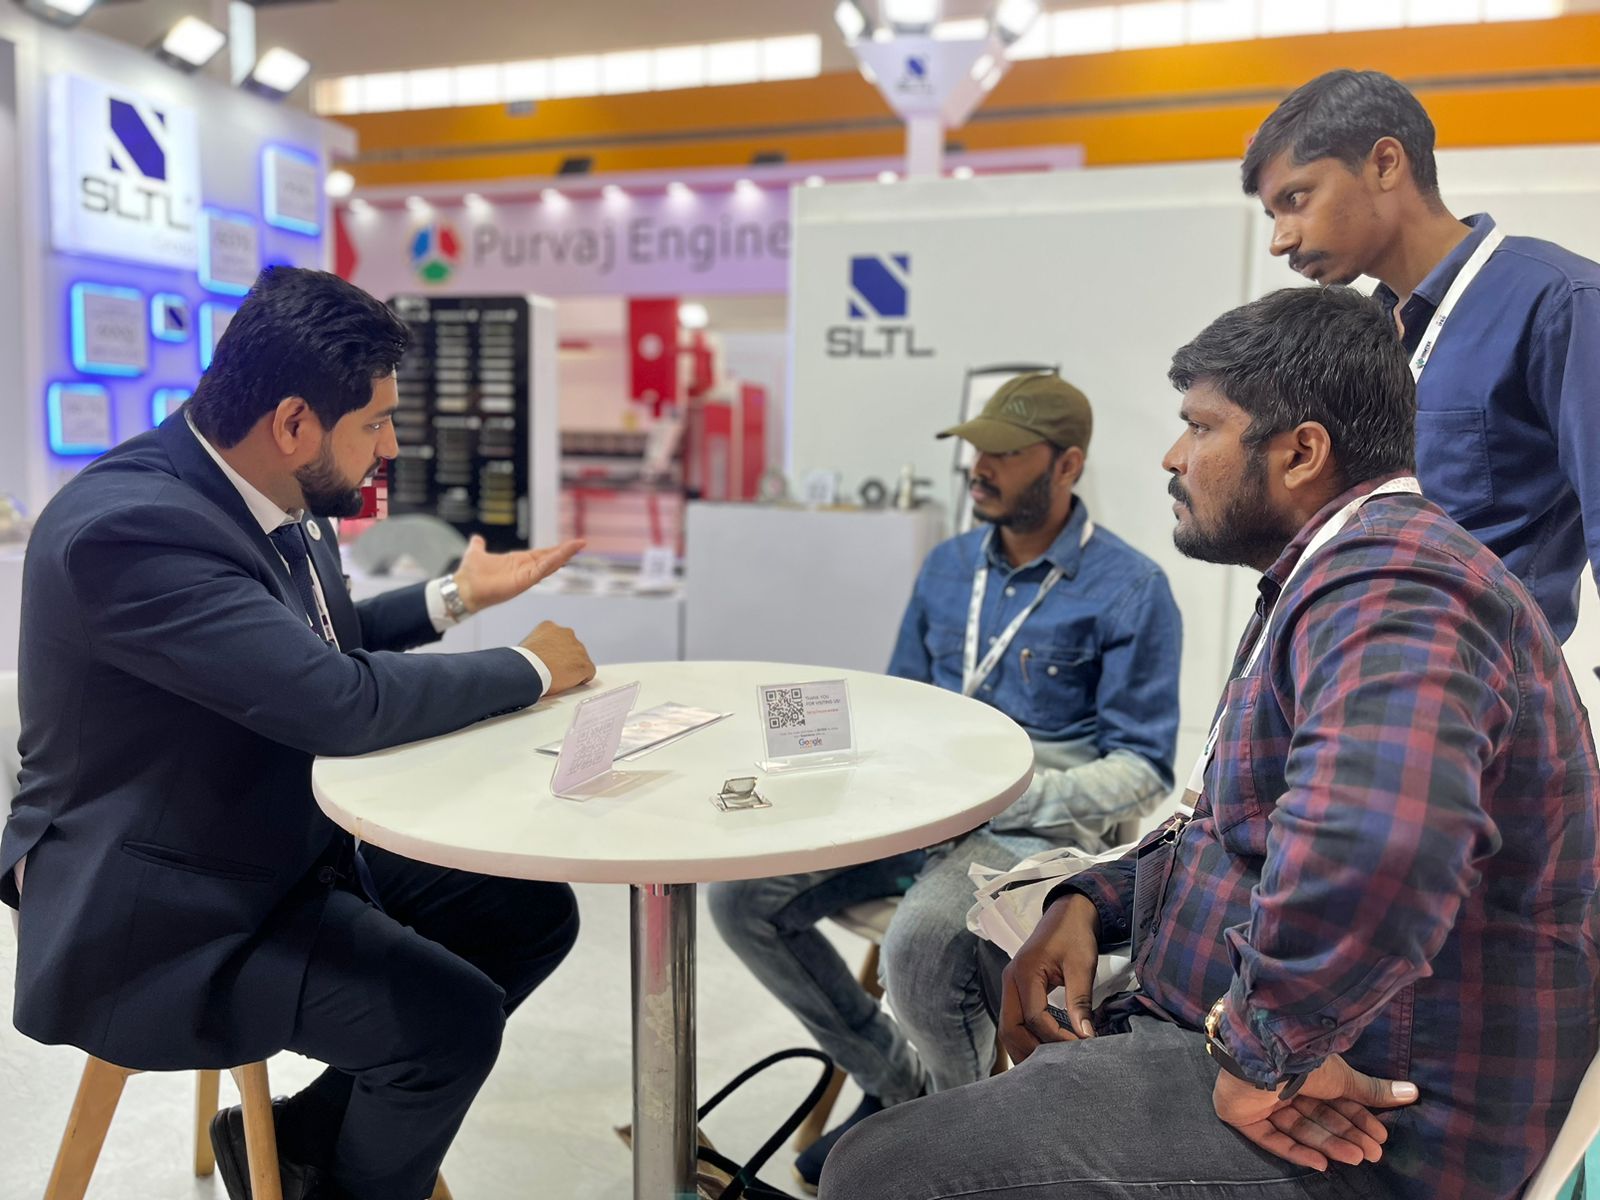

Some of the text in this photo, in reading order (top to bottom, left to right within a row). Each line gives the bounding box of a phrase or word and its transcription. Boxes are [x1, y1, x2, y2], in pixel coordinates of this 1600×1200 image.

[81, 176, 191, 231] SLTL
[474, 216, 790, 274] Purvaj Engine
[825, 324, 936, 358] SLTL
[798, 737, 823, 748] Google
